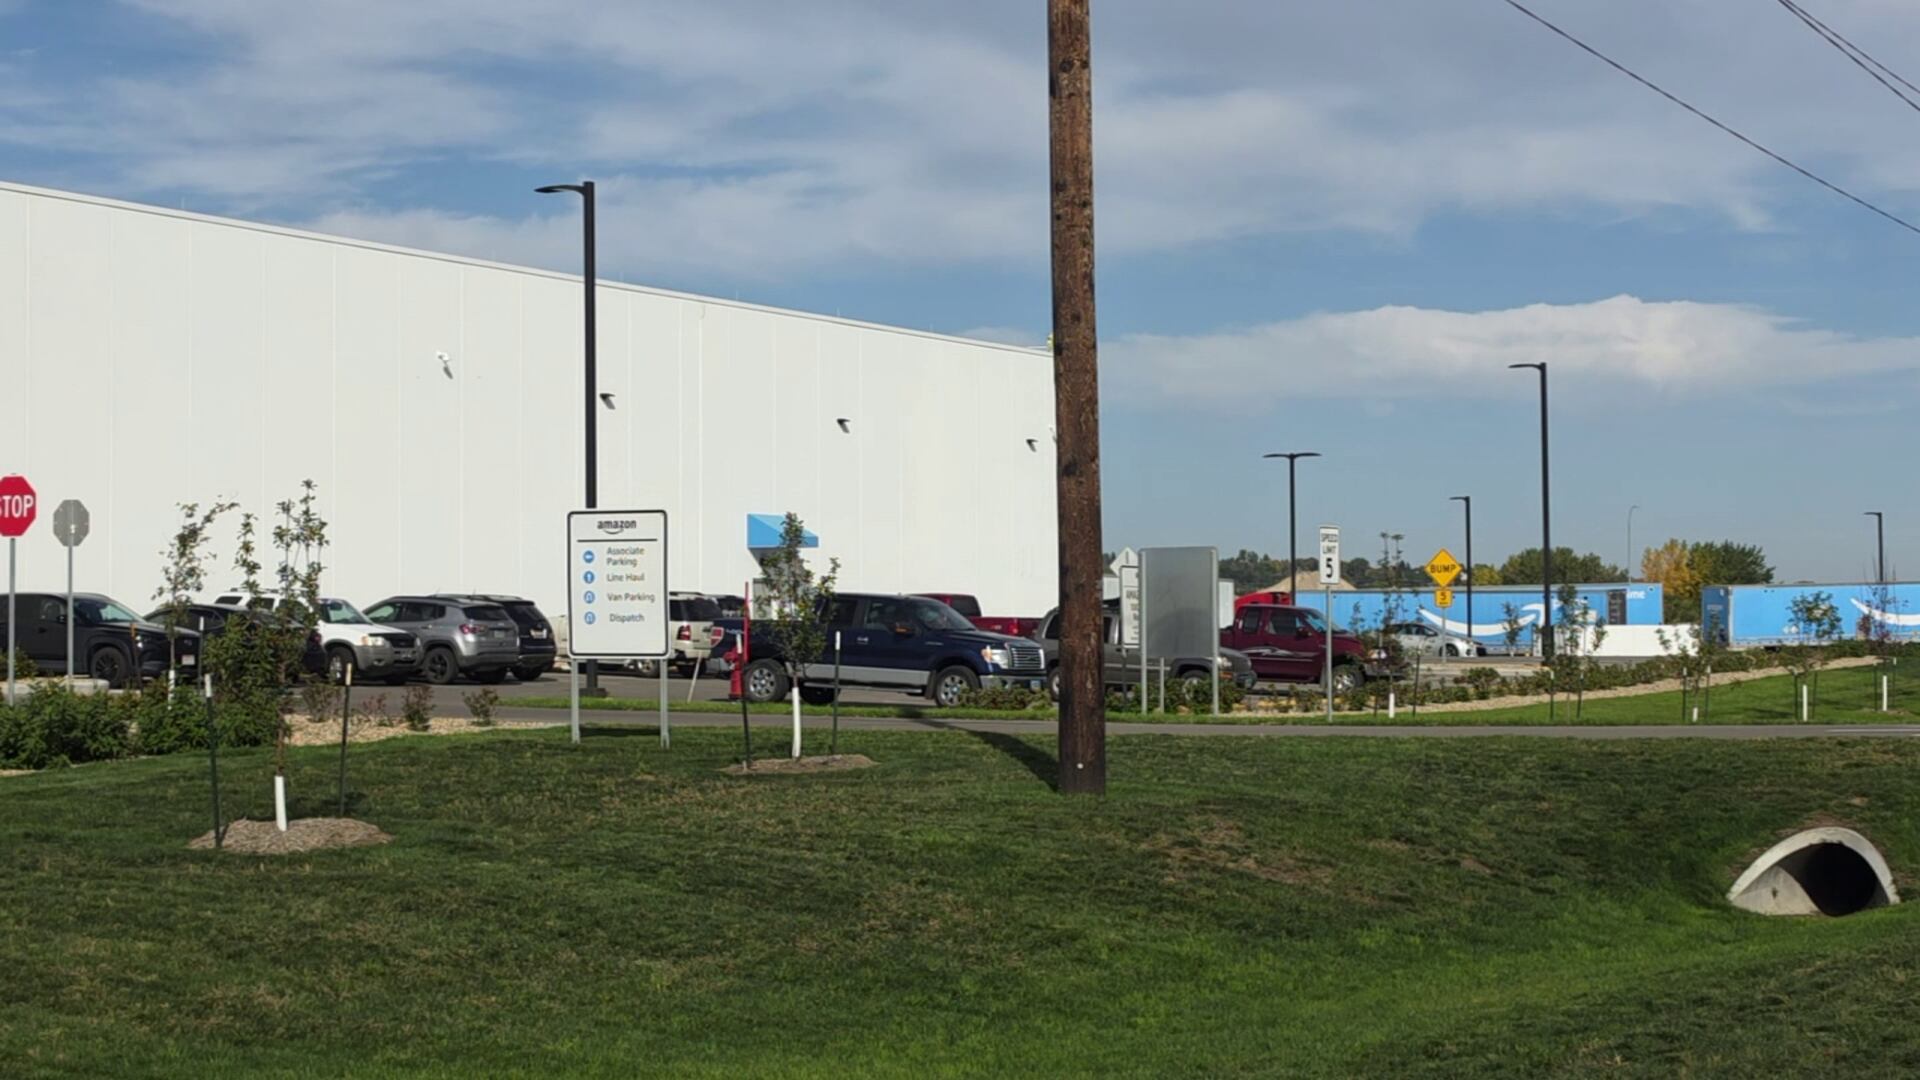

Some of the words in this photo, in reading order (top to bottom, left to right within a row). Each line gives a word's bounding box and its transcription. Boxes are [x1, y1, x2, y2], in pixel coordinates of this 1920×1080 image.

[0, 495, 34, 518] TOP
[597, 520, 637, 530] amazon
[1321, 533, 1337, 542] SPEED
[606, 547, 645, 555] Associate
[1322, 545, 1336, 554] LIMIT
[606, 557, 638, 568] Parking
[1326, 557, 1334, 578] 5
[1430, 564, 1456, 573] BUMP
[606, 572, 624, 581] Line
[625, 572, 645, 581] Haul
[607, 593, 622, 601] Van
[624, 592, 655, 603] Parking
[1440, 591, 1447, 601] 5
[609, 613, 645, 623] Dispatch
